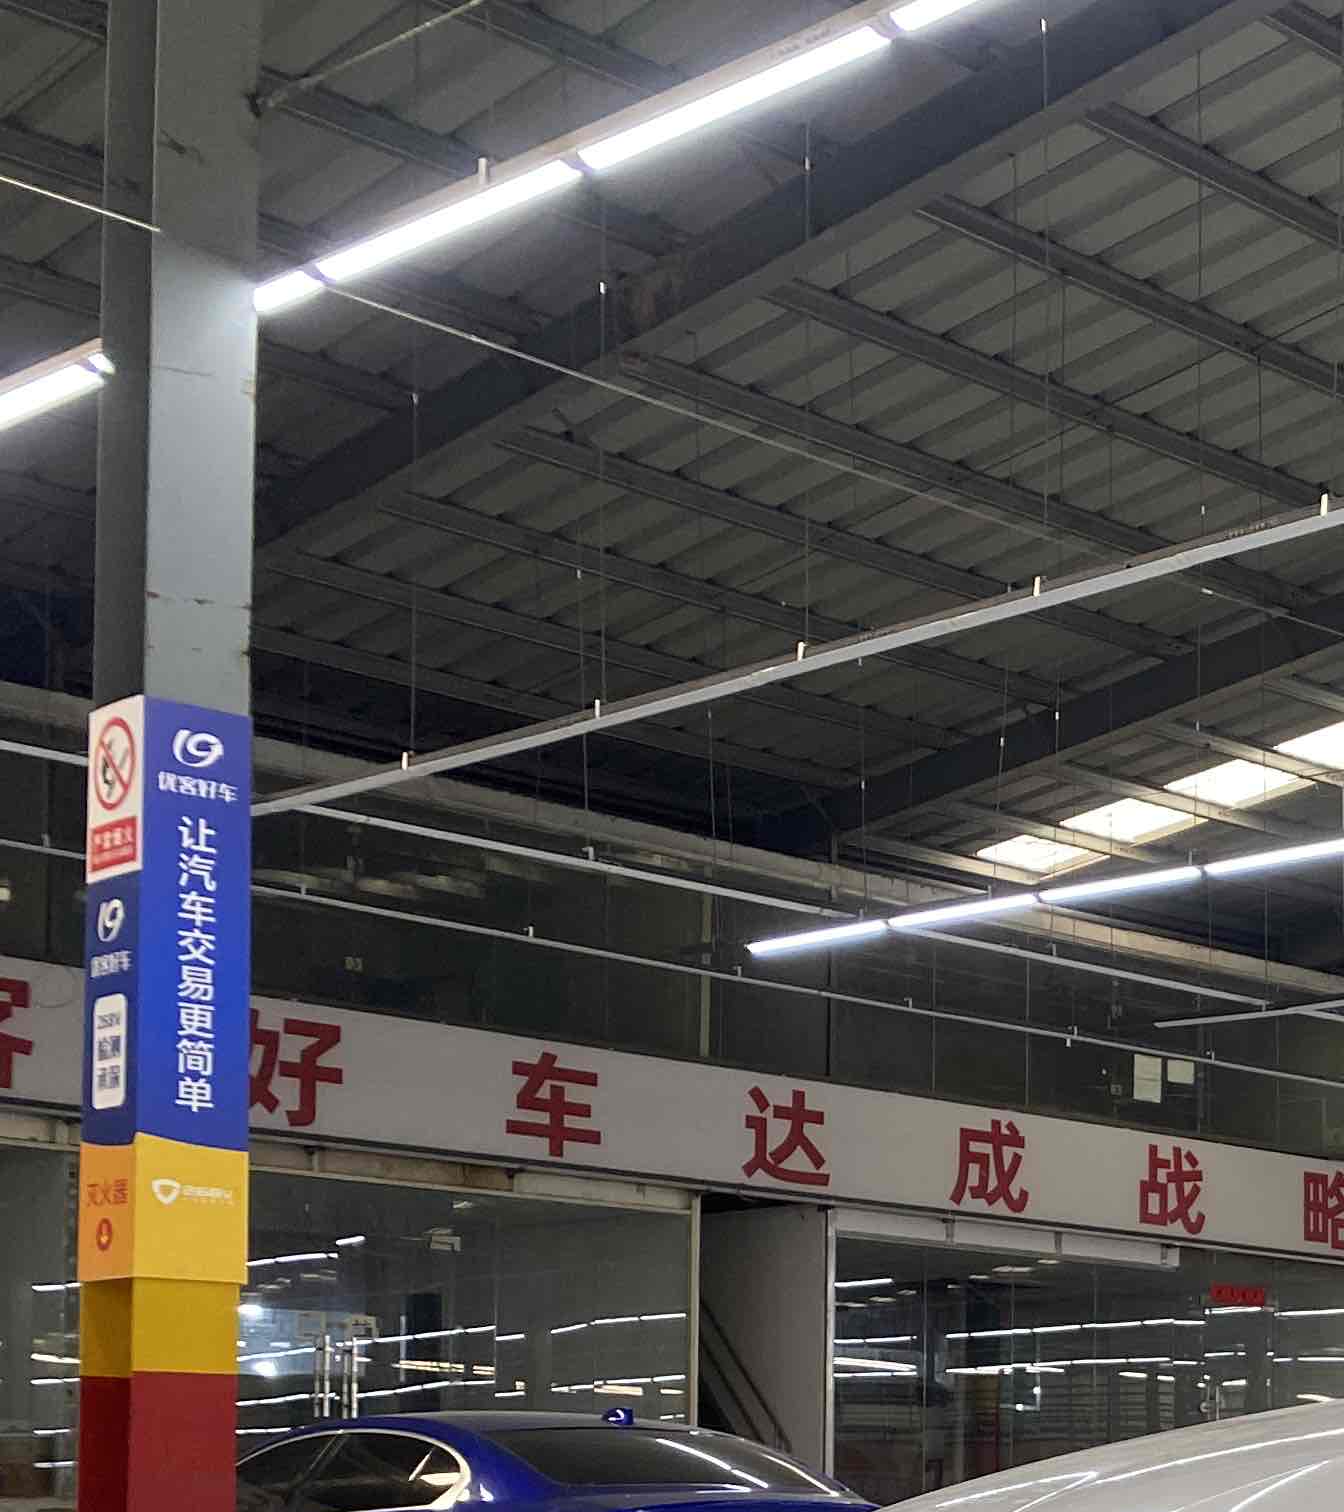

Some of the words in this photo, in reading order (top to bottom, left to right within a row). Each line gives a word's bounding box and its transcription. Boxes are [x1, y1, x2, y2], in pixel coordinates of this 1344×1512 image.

[175, 815, 218, 1112] 让汽车交易更简单
